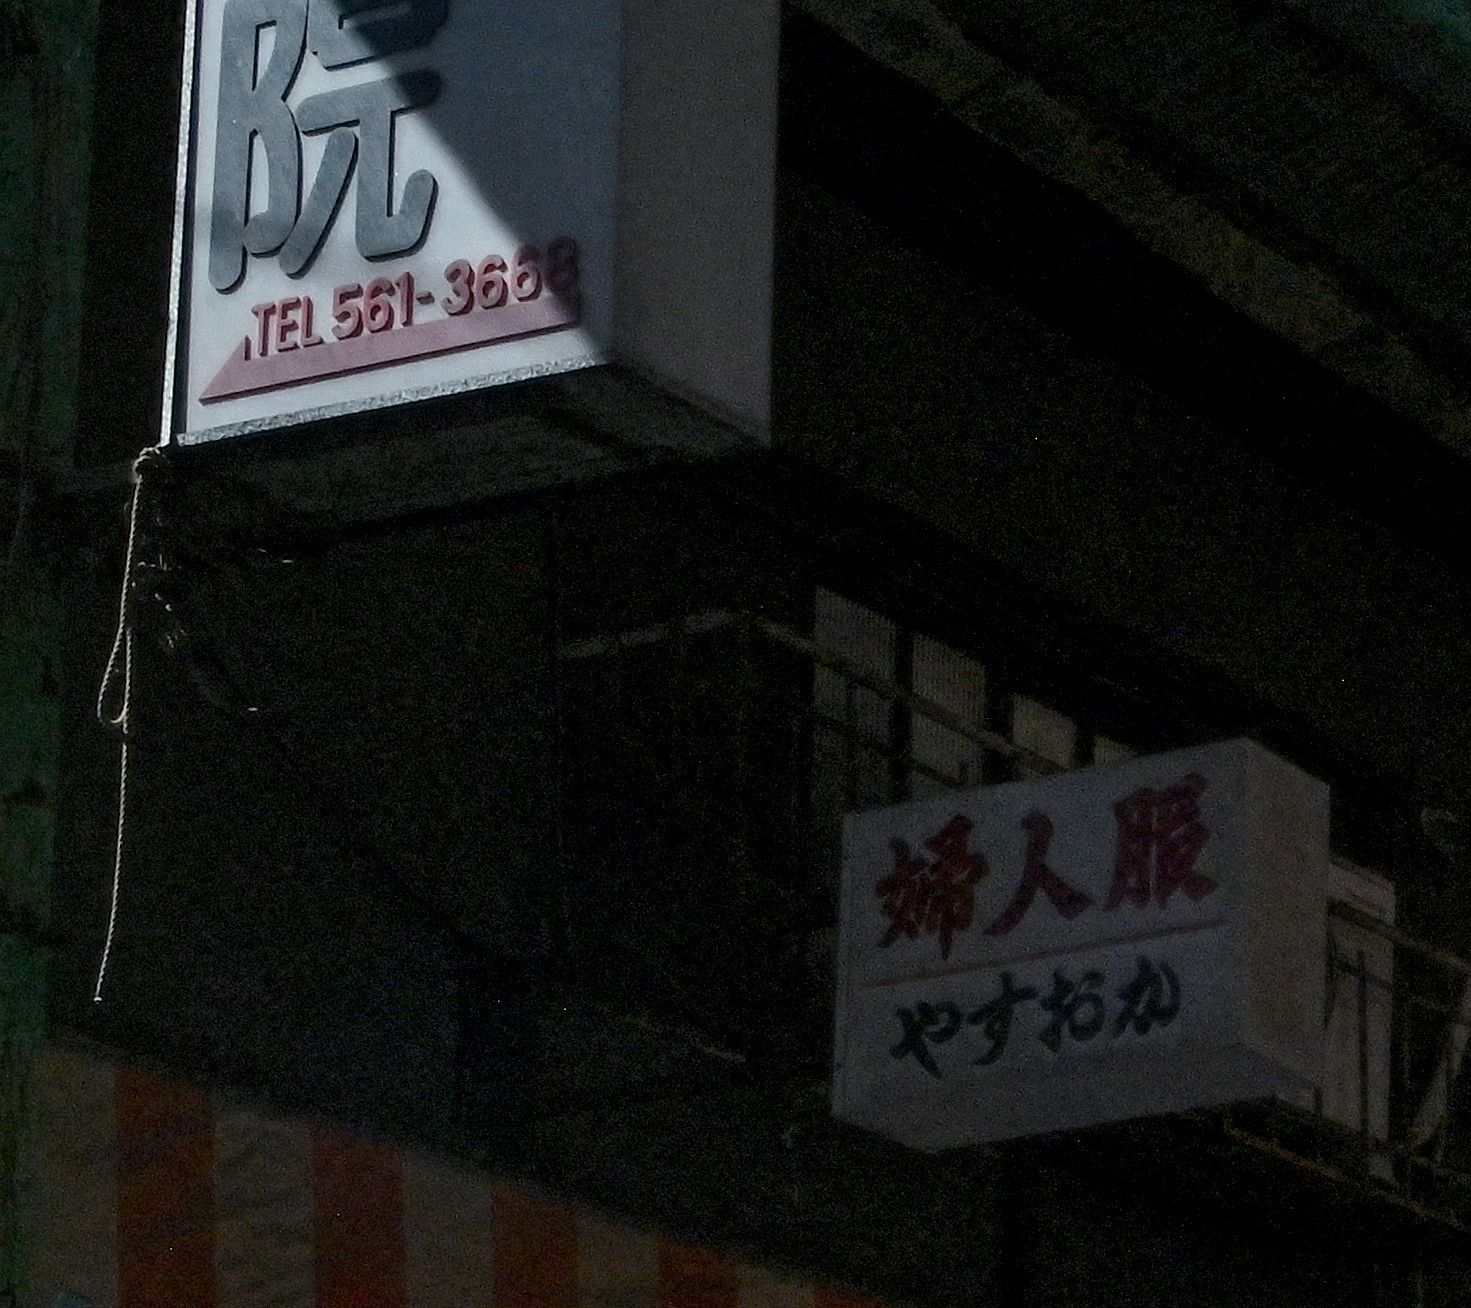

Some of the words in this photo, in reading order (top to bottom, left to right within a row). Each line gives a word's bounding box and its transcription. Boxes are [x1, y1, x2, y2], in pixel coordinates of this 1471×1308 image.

[251, 294, 325, 358] TEL
[874, 772, 1219, 960] 婦人服
[890, 954, 1181, 1078] やすおか
